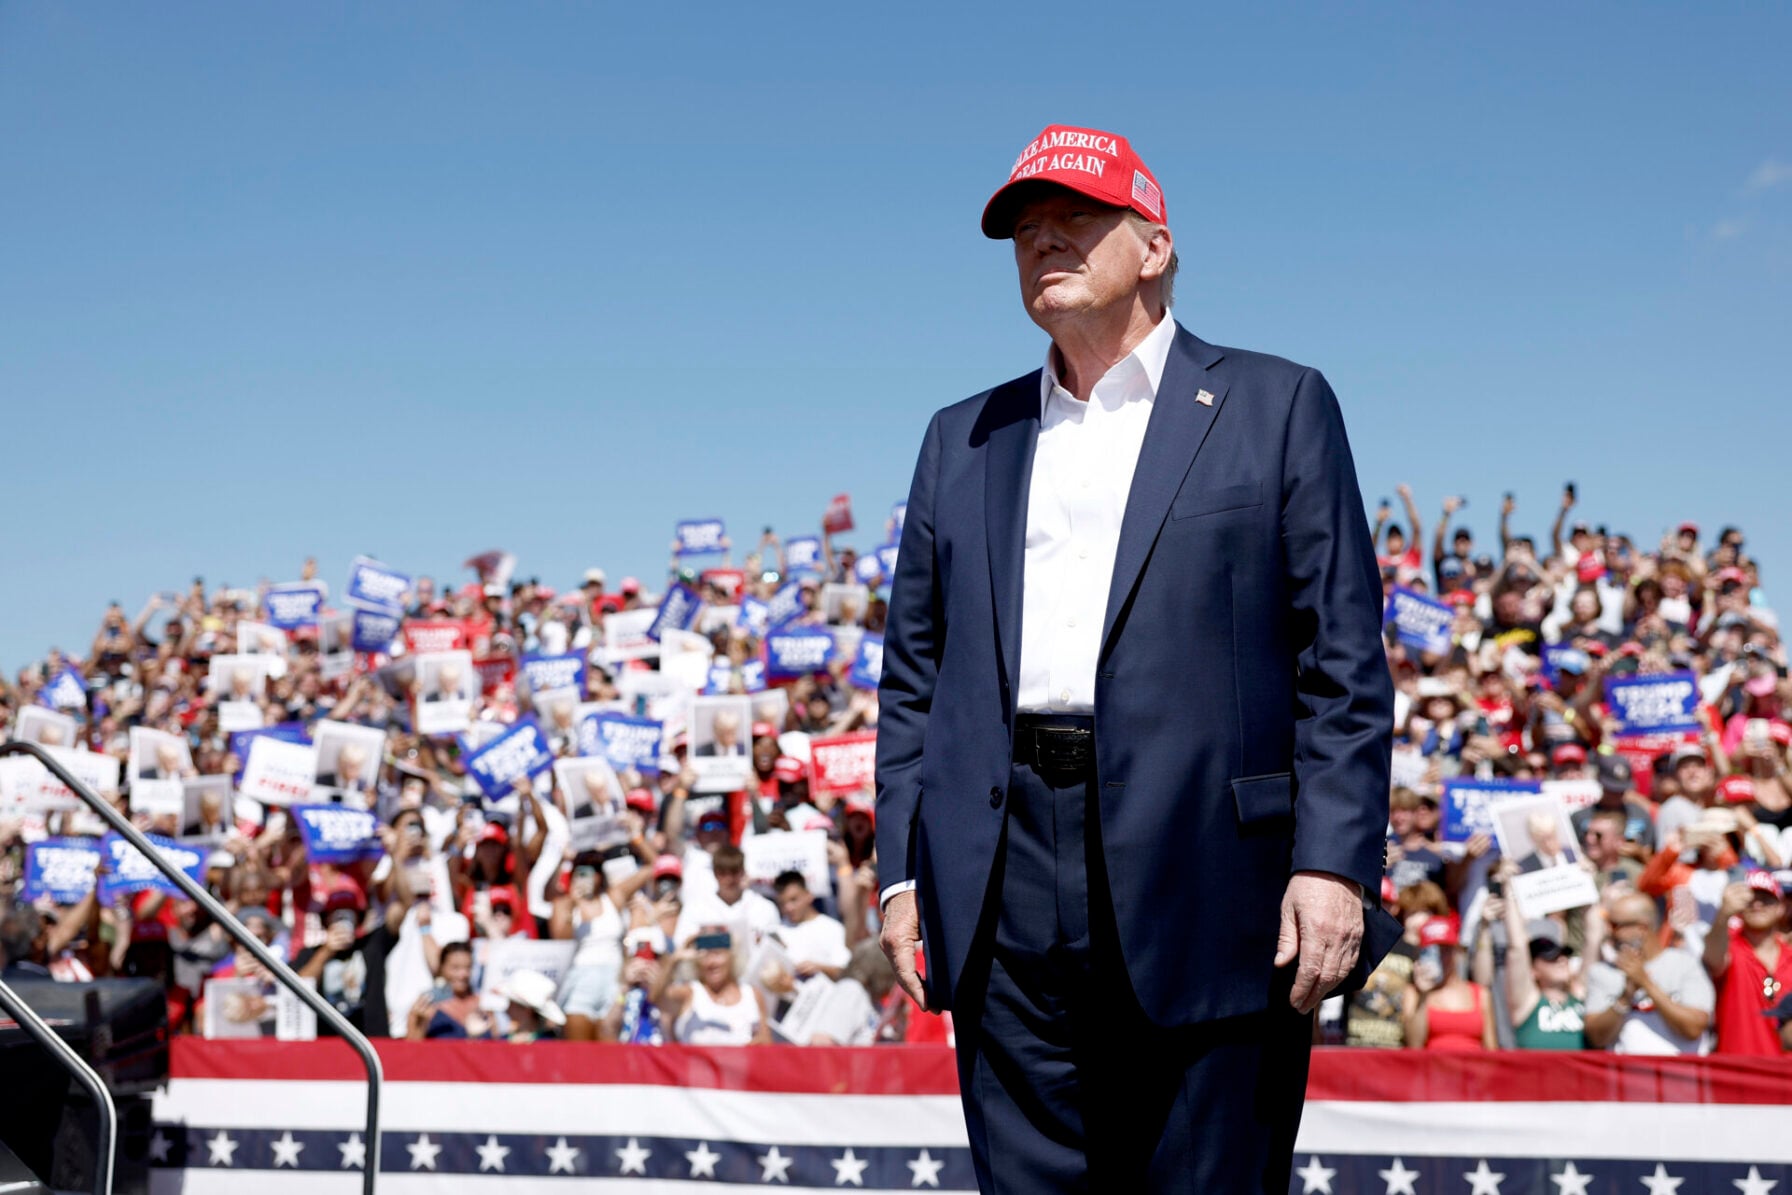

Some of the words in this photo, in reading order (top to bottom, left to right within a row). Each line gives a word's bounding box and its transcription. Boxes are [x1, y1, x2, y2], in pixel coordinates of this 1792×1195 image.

[1039, 131, 1118, 157] AMERICA
[1048, 153, 1106, 178] AGAIN
[1612, 681, 1692, 705] TRUMP
[1626, 698, 1683, 719] 2024
